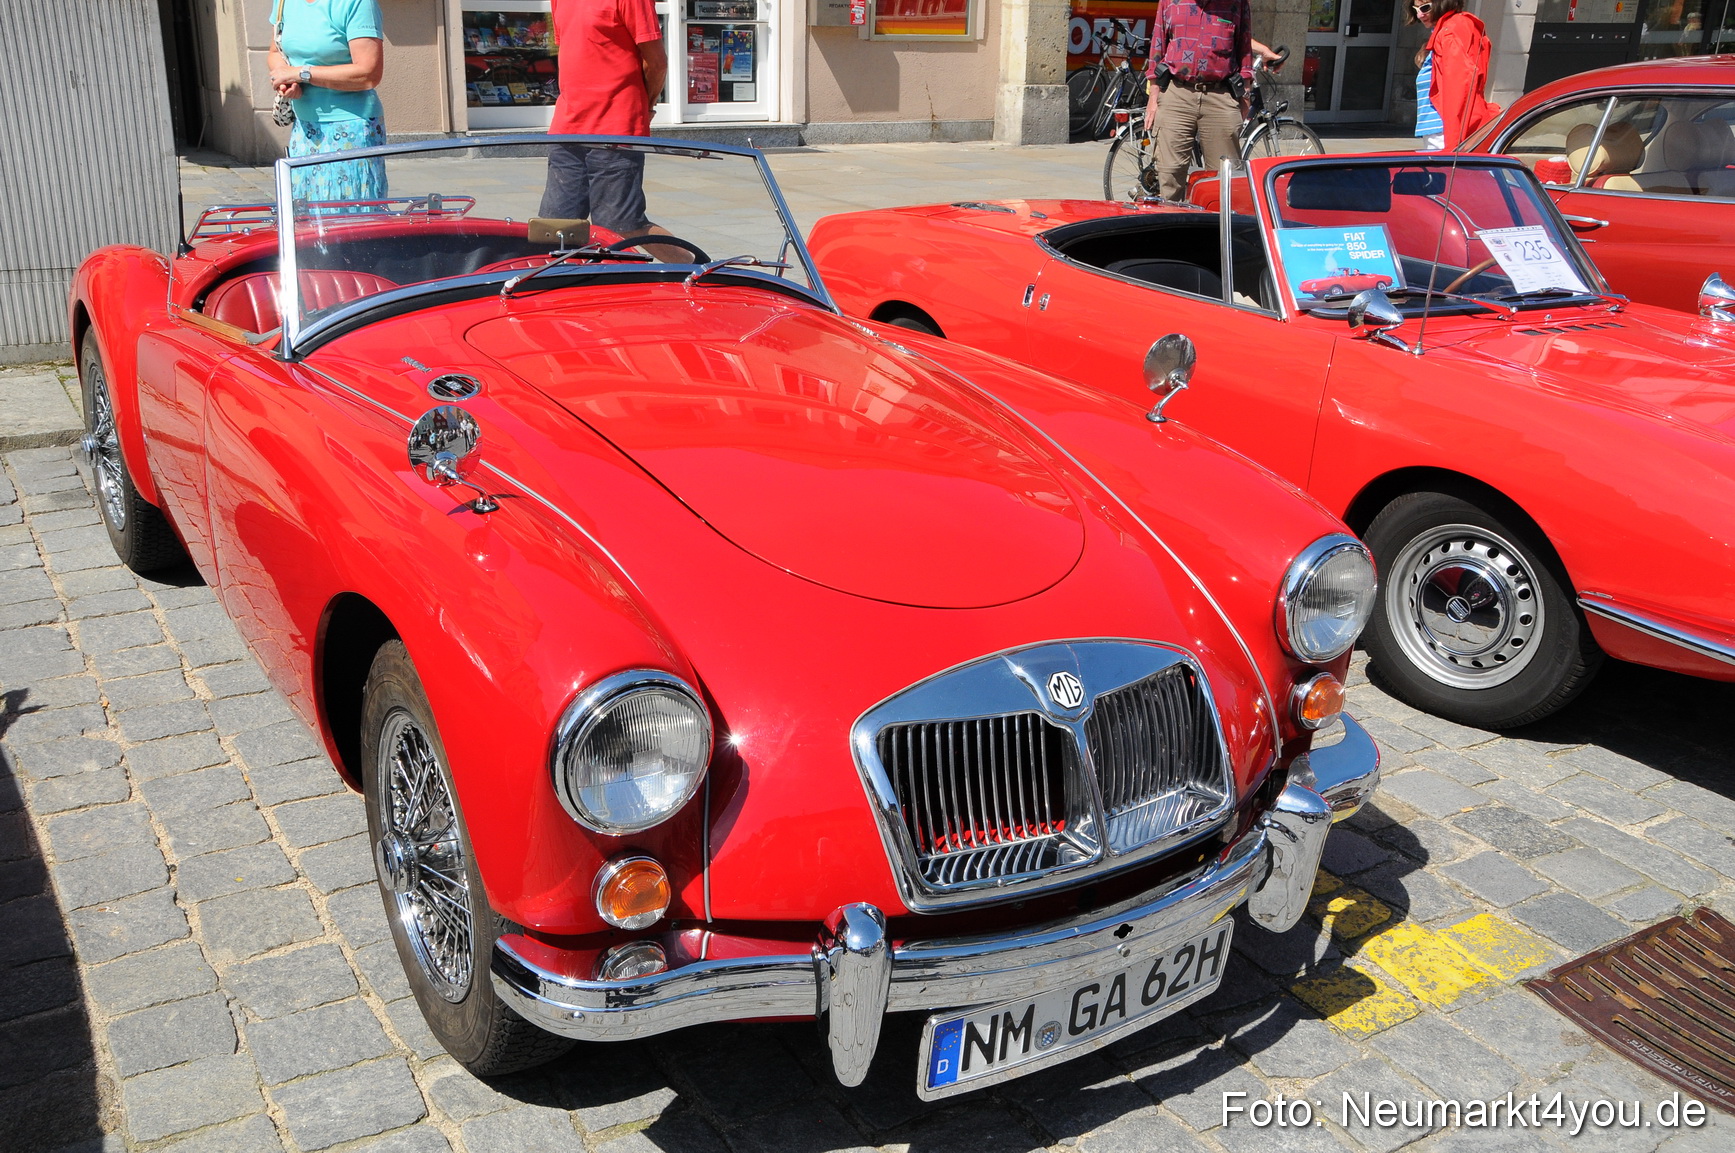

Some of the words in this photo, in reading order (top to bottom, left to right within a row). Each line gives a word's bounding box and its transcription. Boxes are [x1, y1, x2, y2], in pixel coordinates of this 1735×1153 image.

[1343, 232, 1365, 241] FIAT
[1346, 241, 1367, 251] 850
[1349, 250, 1385, 259] SPIDER
[1514, 240, 1552, 261] 235
[1053, 674, 1082, 704] MG
[961, 1004, 1036, 1072] NM
[1068, 972, 1127, 1036] GA
[1140, 929, 1228, 1007] 62H
[936, 1058, 949, 1075] D
